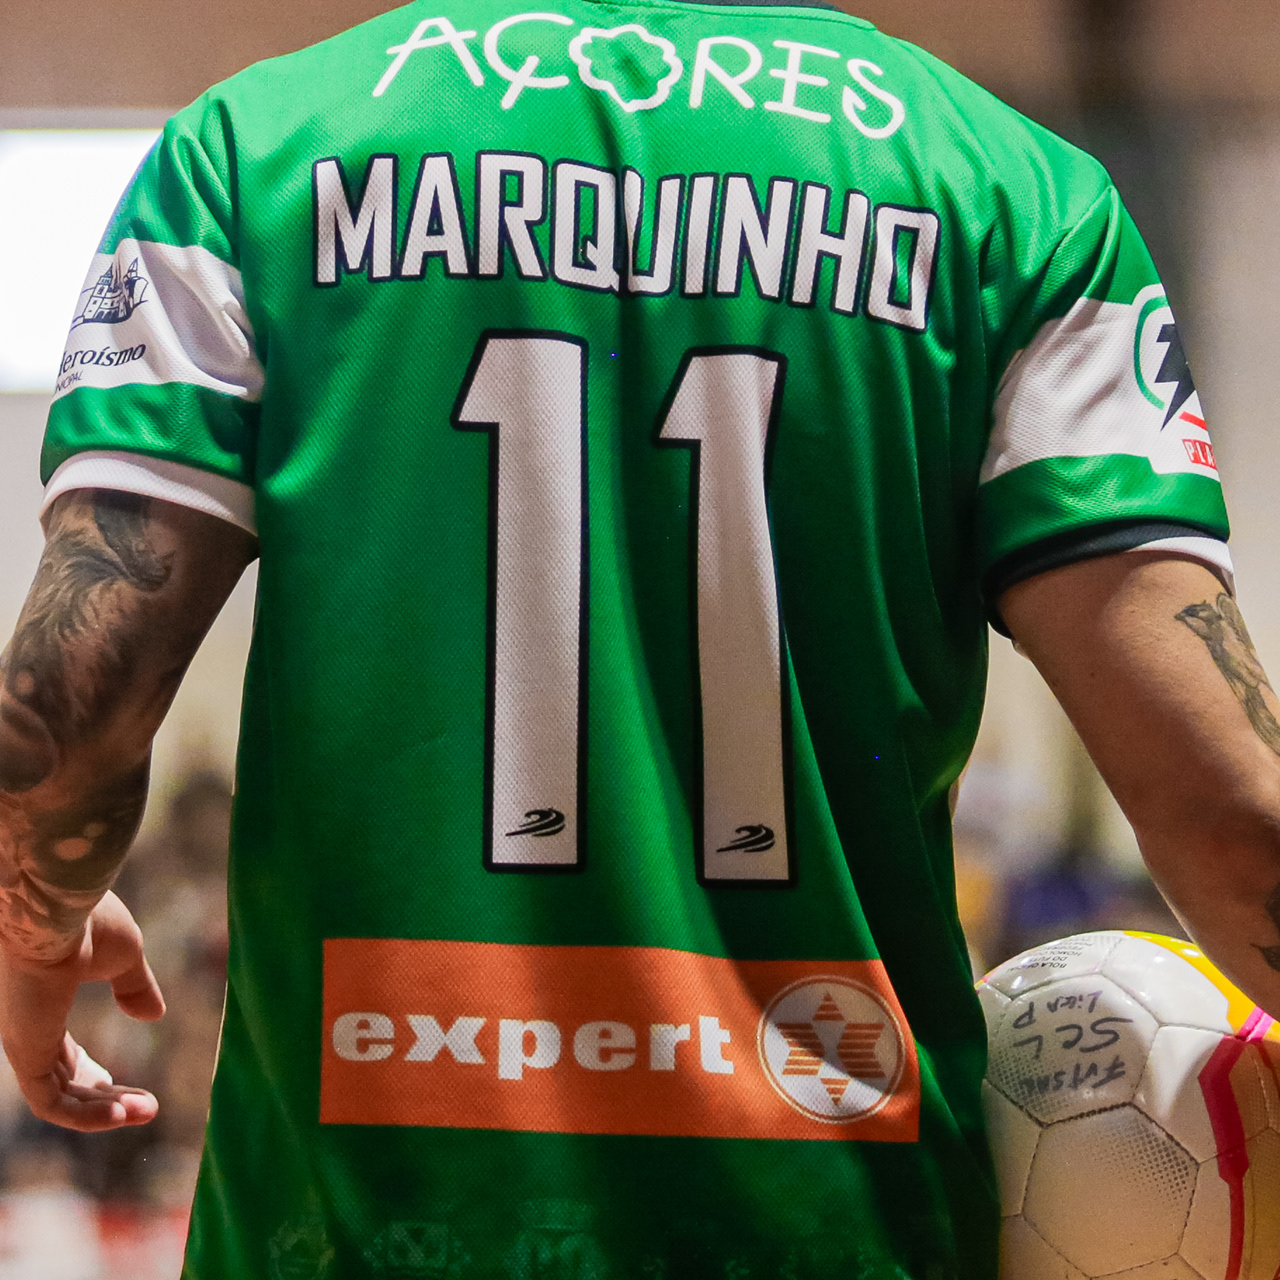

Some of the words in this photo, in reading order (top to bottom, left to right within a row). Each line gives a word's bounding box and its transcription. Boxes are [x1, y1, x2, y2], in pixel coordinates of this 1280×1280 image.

[372, 12, 905, 139] AÇORES
[312, 150, 939, 332] MARQUINHO
[450, 328, 797, 888] 11
[331, 1011, 735, 1081] expert
